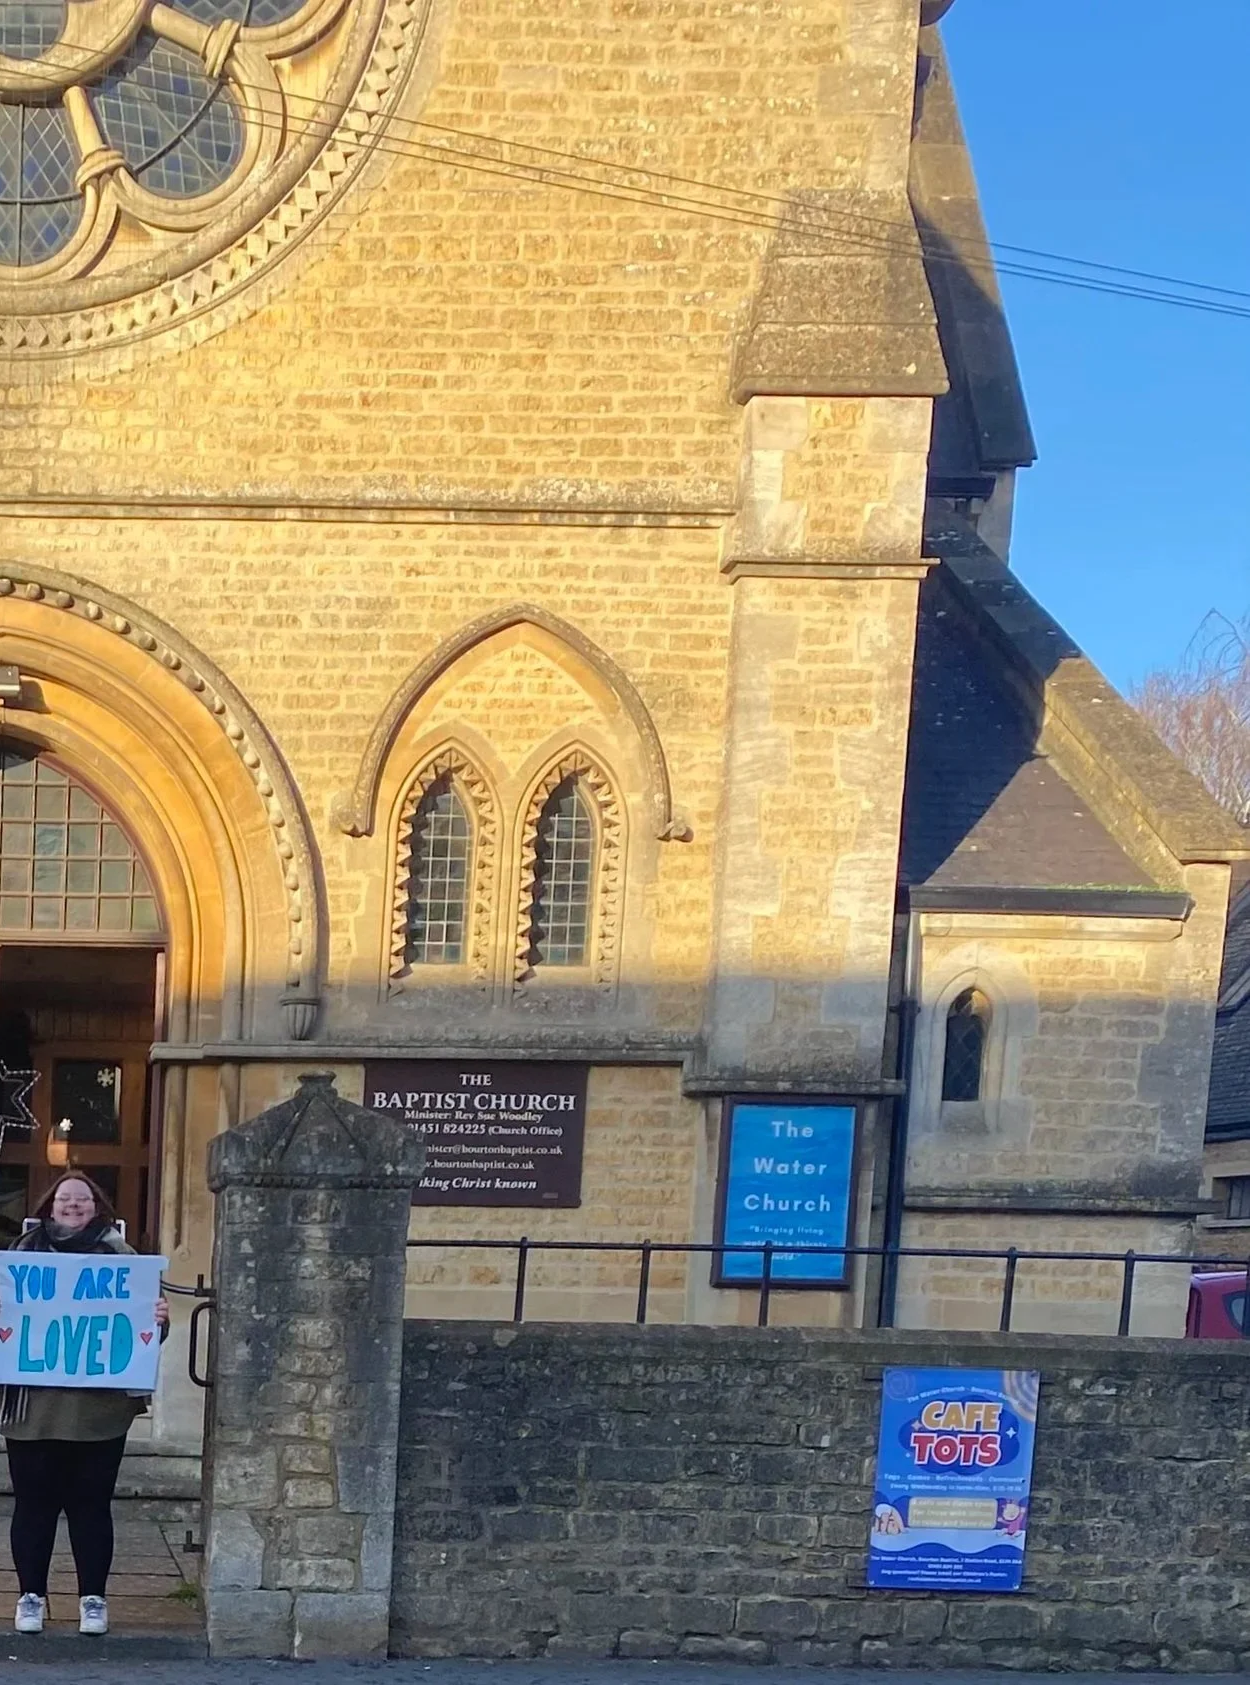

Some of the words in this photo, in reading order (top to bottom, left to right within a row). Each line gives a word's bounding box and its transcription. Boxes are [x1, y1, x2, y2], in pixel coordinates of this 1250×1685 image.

[459, 1073, 492, 1086] THE
[372, 1092, 471, 1109] BAPTIST
[473, 1093, 576, 1111] CHURCH
[404, 1110, 451, 1120] Minister:
[455, 1111, 473, 1120] Rev
[477, 1111, 496, 1121] Sue
[499, 1112, 543, 1124] Woodley
[442, 1124, 486, 1135] 824225
[488, 1126, 528, 1137] (Church
[530, 1126, 563, 1137] Office)
[771, 1120, 814, 1138] The
[427, 1145, 563, 1157] nister@bourtonbaptist.co.uk
[753, 1157, 828, 1176] Water
[451, 1177, 491, 1189] Christ
[494, 1178, 537, 1190] known
[743, 1193, 831, 1212] Church
[8, 1264, 57, 1304] YOU
[73, 1266, 131, 1300] ARE
[18, 1312, 133, 1375] LOVED
[921, 1400, 1003, 1432] CAFE
[911, 1432, 1001, 1467] TOTS
